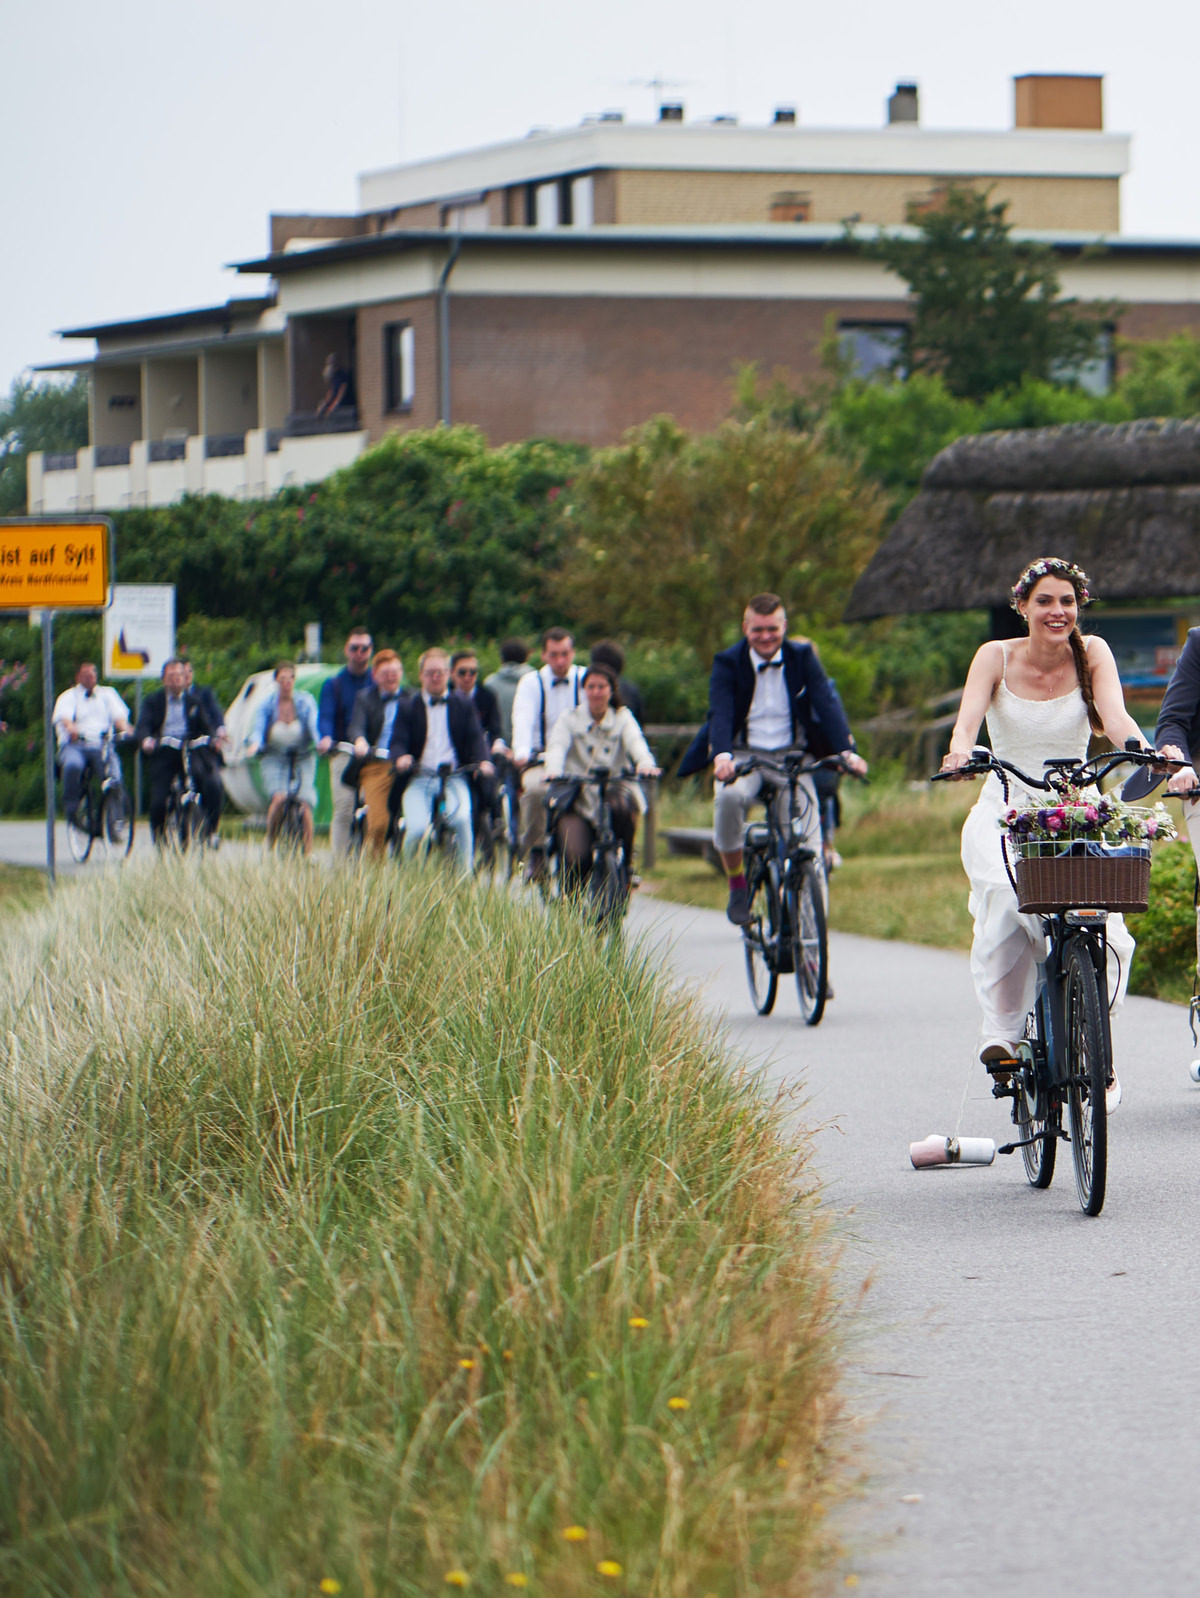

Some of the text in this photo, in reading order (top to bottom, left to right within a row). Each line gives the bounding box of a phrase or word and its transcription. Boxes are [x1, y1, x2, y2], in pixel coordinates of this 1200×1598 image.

[0, 543, 95, 570] ist auf Sylt
